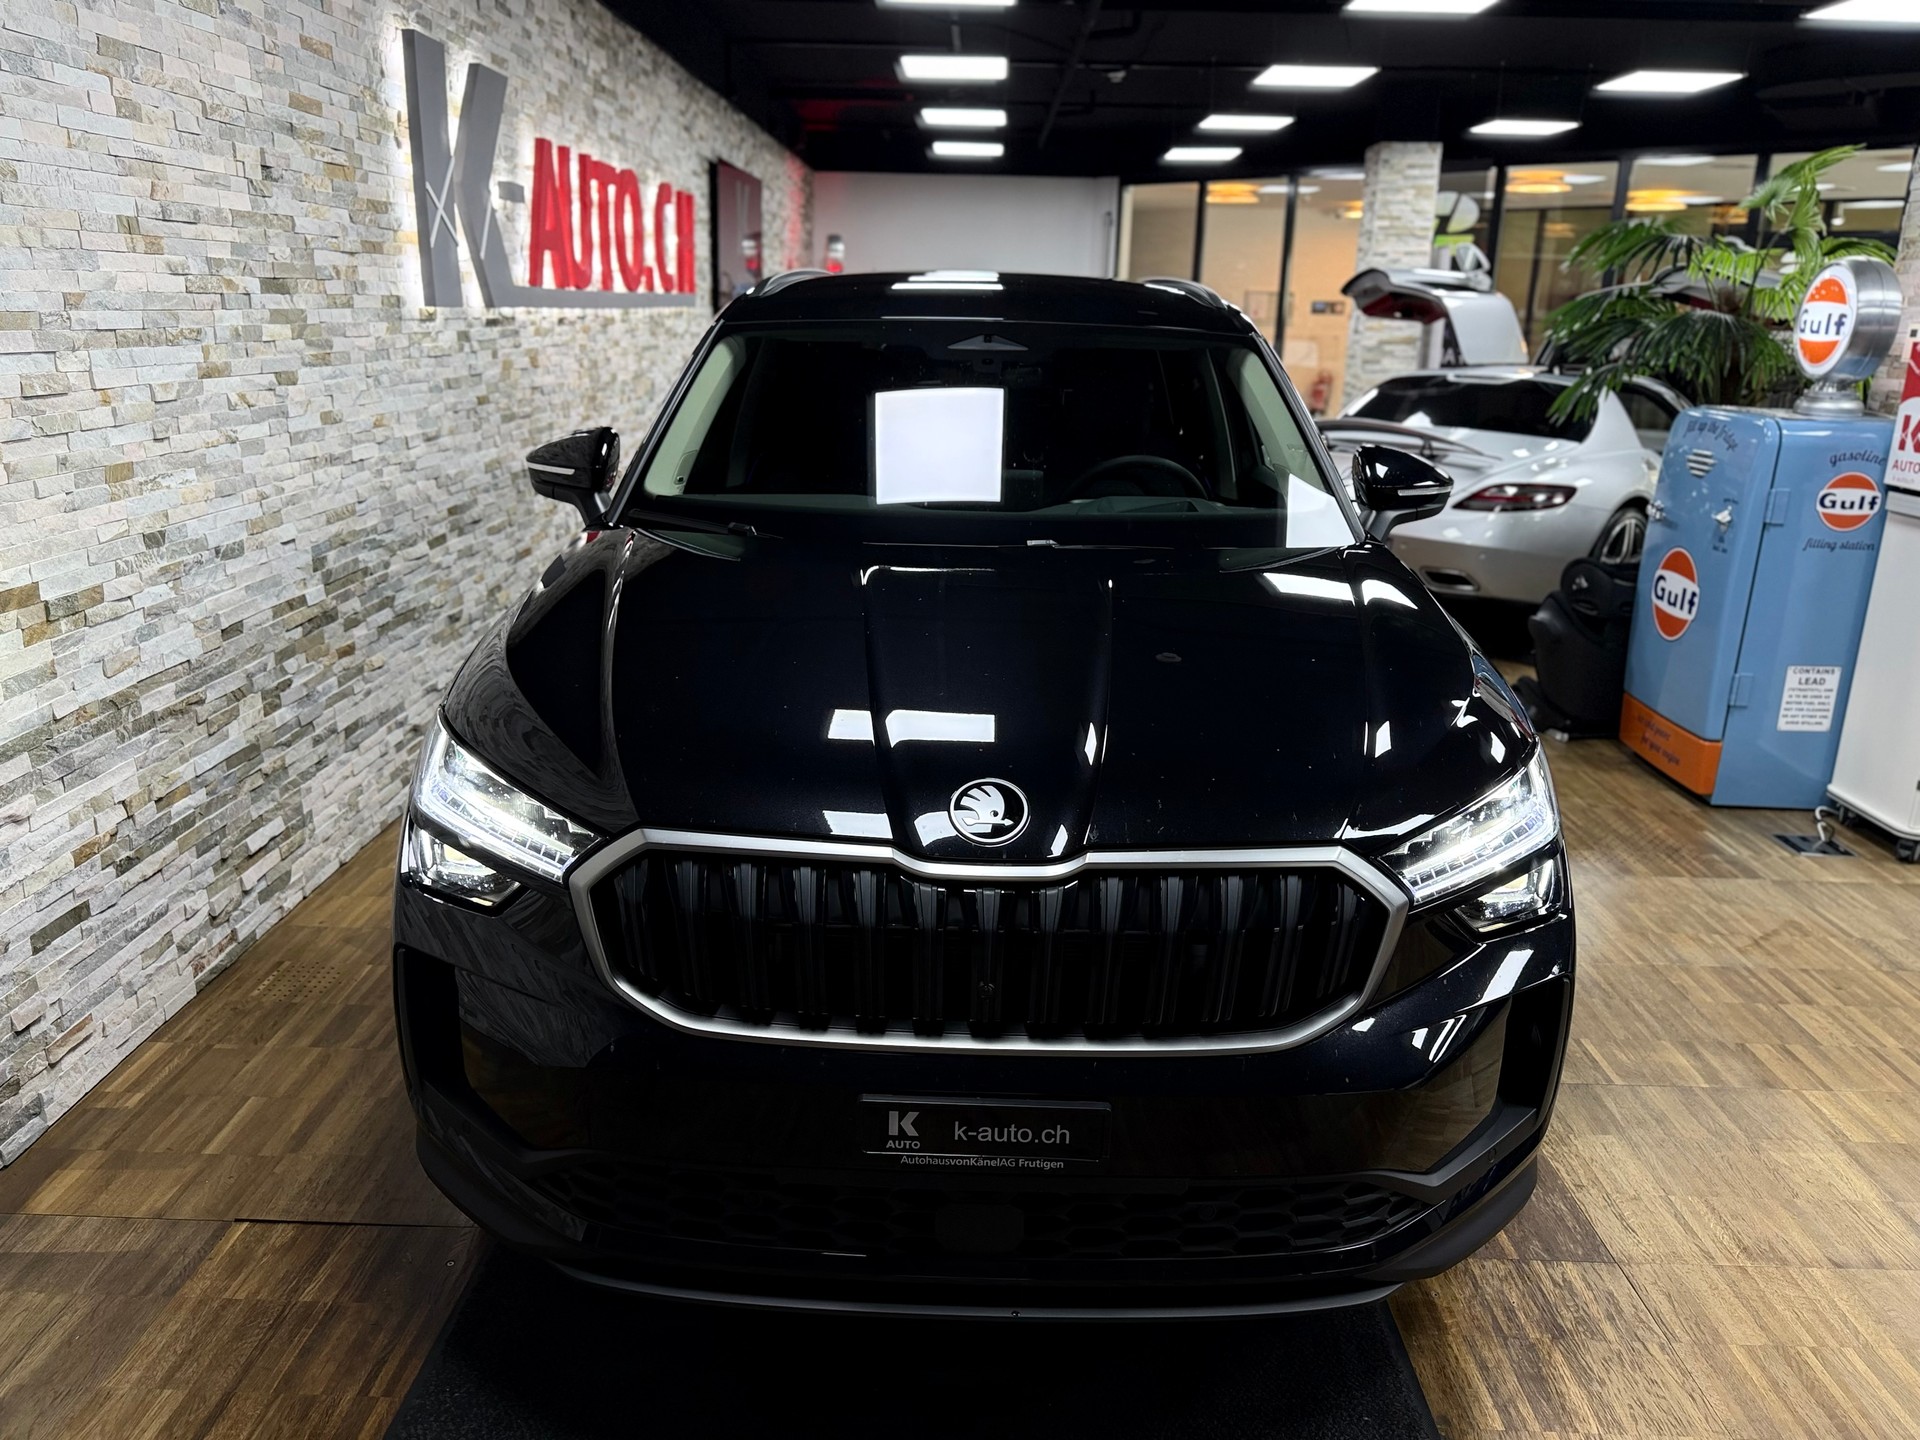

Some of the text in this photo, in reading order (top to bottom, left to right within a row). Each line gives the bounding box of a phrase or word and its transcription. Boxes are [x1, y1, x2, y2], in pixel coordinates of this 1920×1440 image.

[1800, 309, 1847, 336] Gulf
[1829, 449, 1887, 467] gasoline
[1819, 493, 1879, 510] Gulf
[1802, 538, 1875, 552] filling station
[1654, 574, 1697, 615] Gulf
[1793, 667, 1835, 675] CONTAINS
[1798, 677, 1826, 686] LEAD
[888, 1111, 920, 1137] K
[954, 1121, 1070, 1144] k-auto.ch
[886, 1140, 921, 1149] AUTO
[1018, 1158, 1064, 1170] Frutigen
